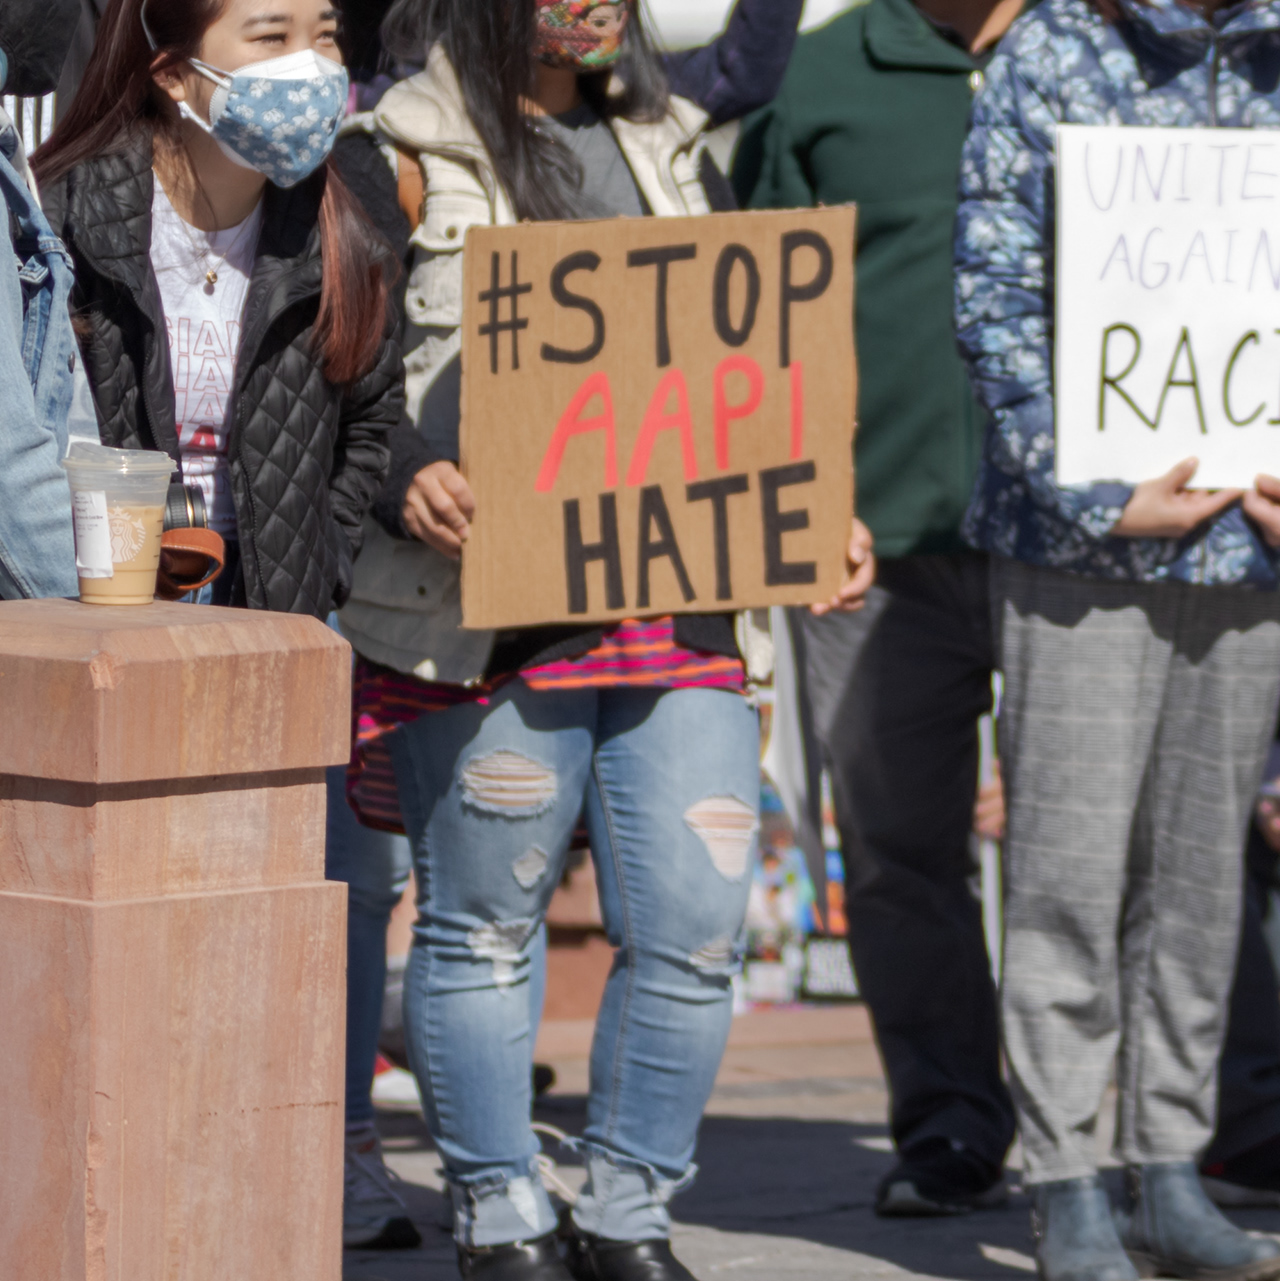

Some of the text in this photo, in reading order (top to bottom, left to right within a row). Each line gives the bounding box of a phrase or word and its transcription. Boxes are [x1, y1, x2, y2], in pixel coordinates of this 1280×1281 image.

[1084, 142, 1279, 212] UNITE
[477, 229, 834, 375] #STOP
[533, 354, 804, 493] AAPI
[562, 460, 818, 615] HATE
